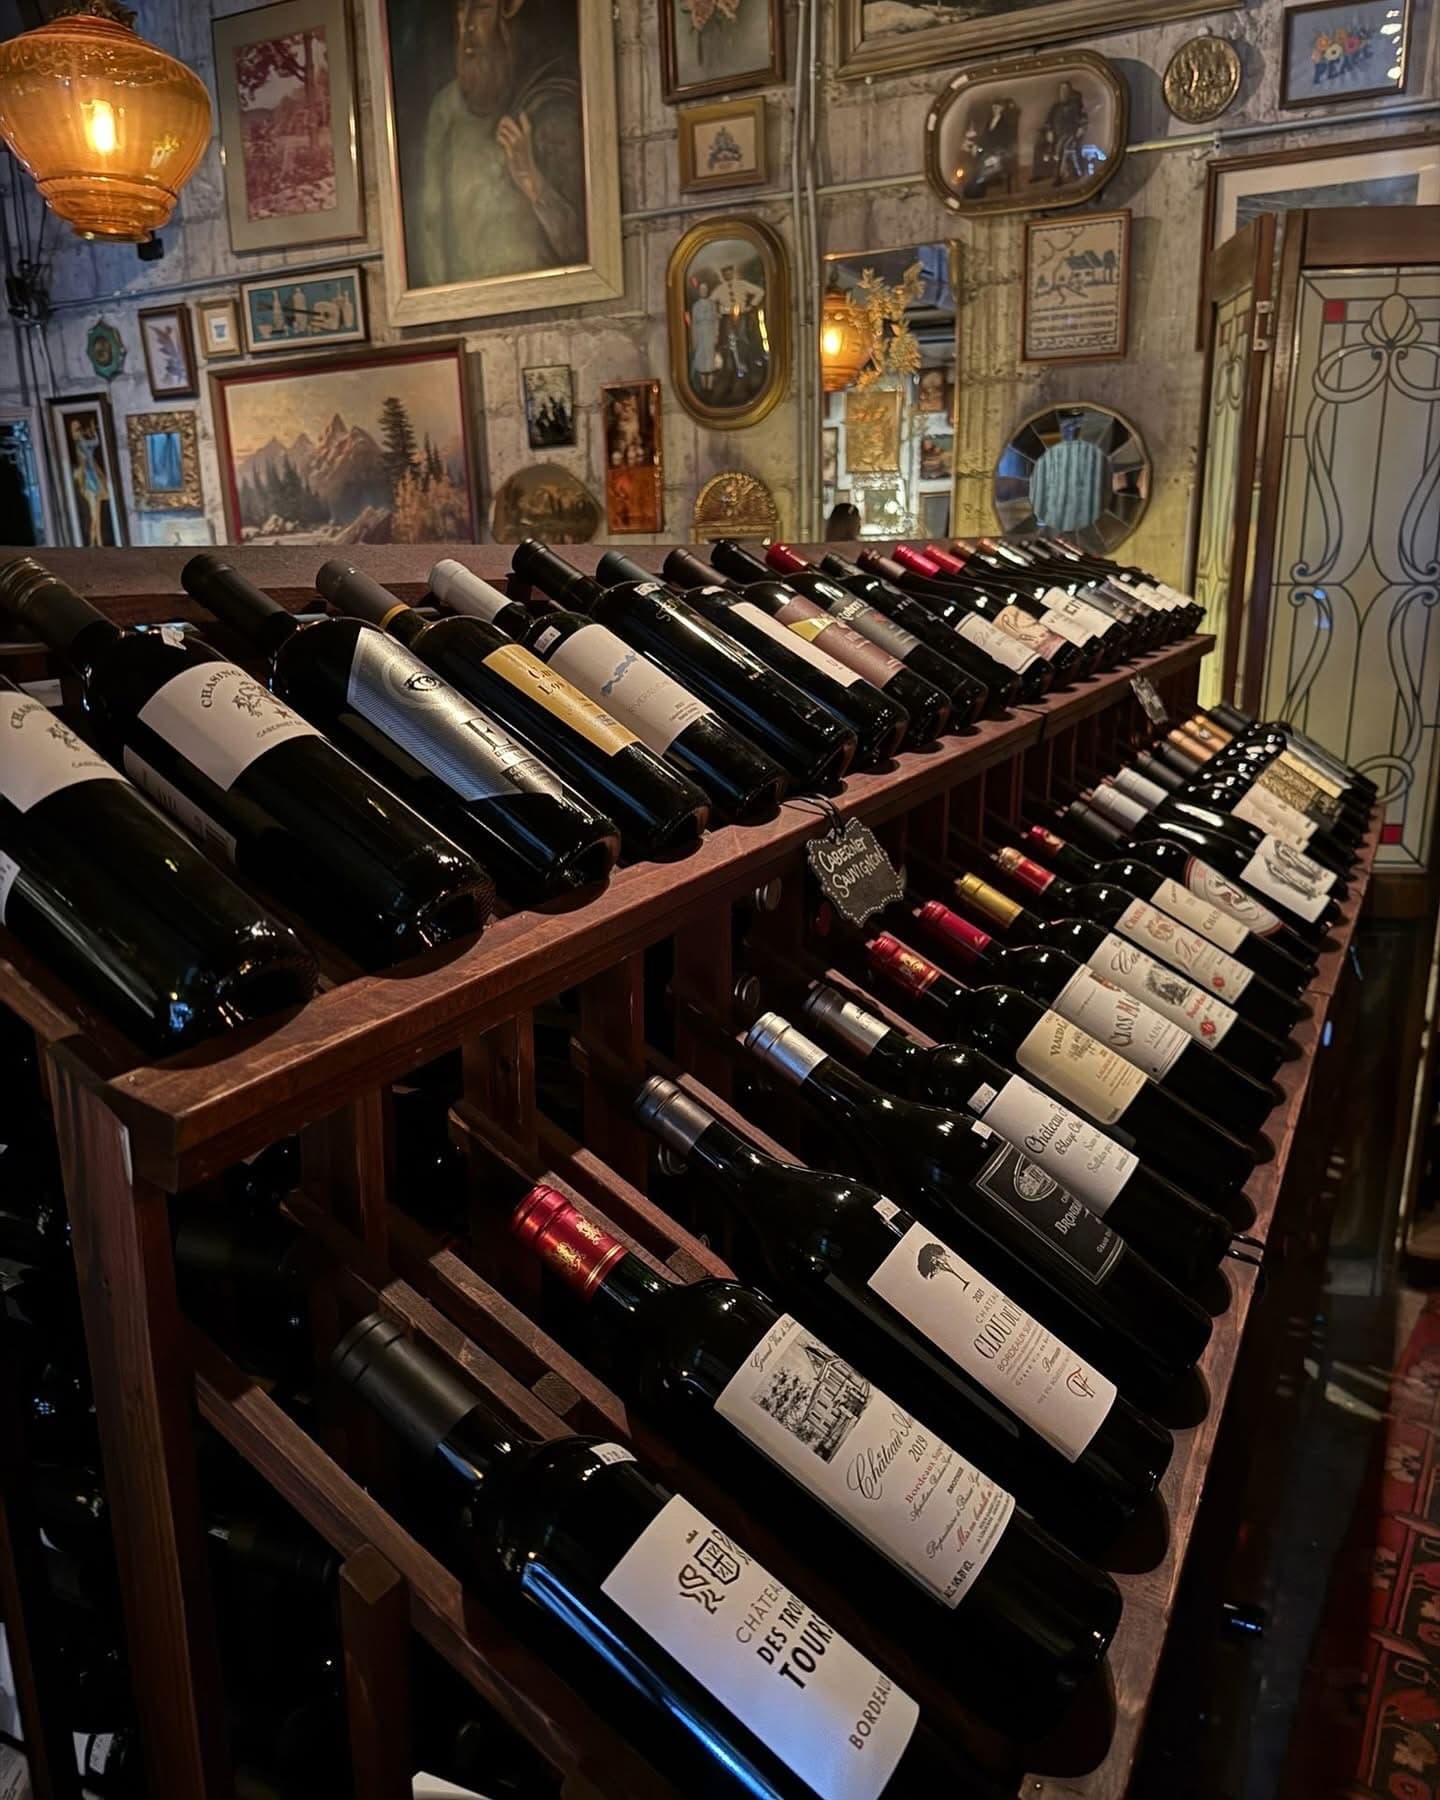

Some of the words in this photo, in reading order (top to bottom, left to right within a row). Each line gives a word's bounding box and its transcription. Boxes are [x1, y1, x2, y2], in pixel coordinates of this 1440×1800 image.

[818, 837, 868, 873] CABERNET
[832, 844, 885, 898] SAUVIGNON
[1024, 1111, 1064, 1154] Château
[973, 1314, 1013, 1360] CLOU
[996, 1334, 1026, 1372] BORDEAUX
[847, 1428, 903, 1500] Château
[908, 1434, 929, 1463] 2019
[905, 1461, 936, 1504] Bordeaux
[756, 1626, 788, 1665] DES
